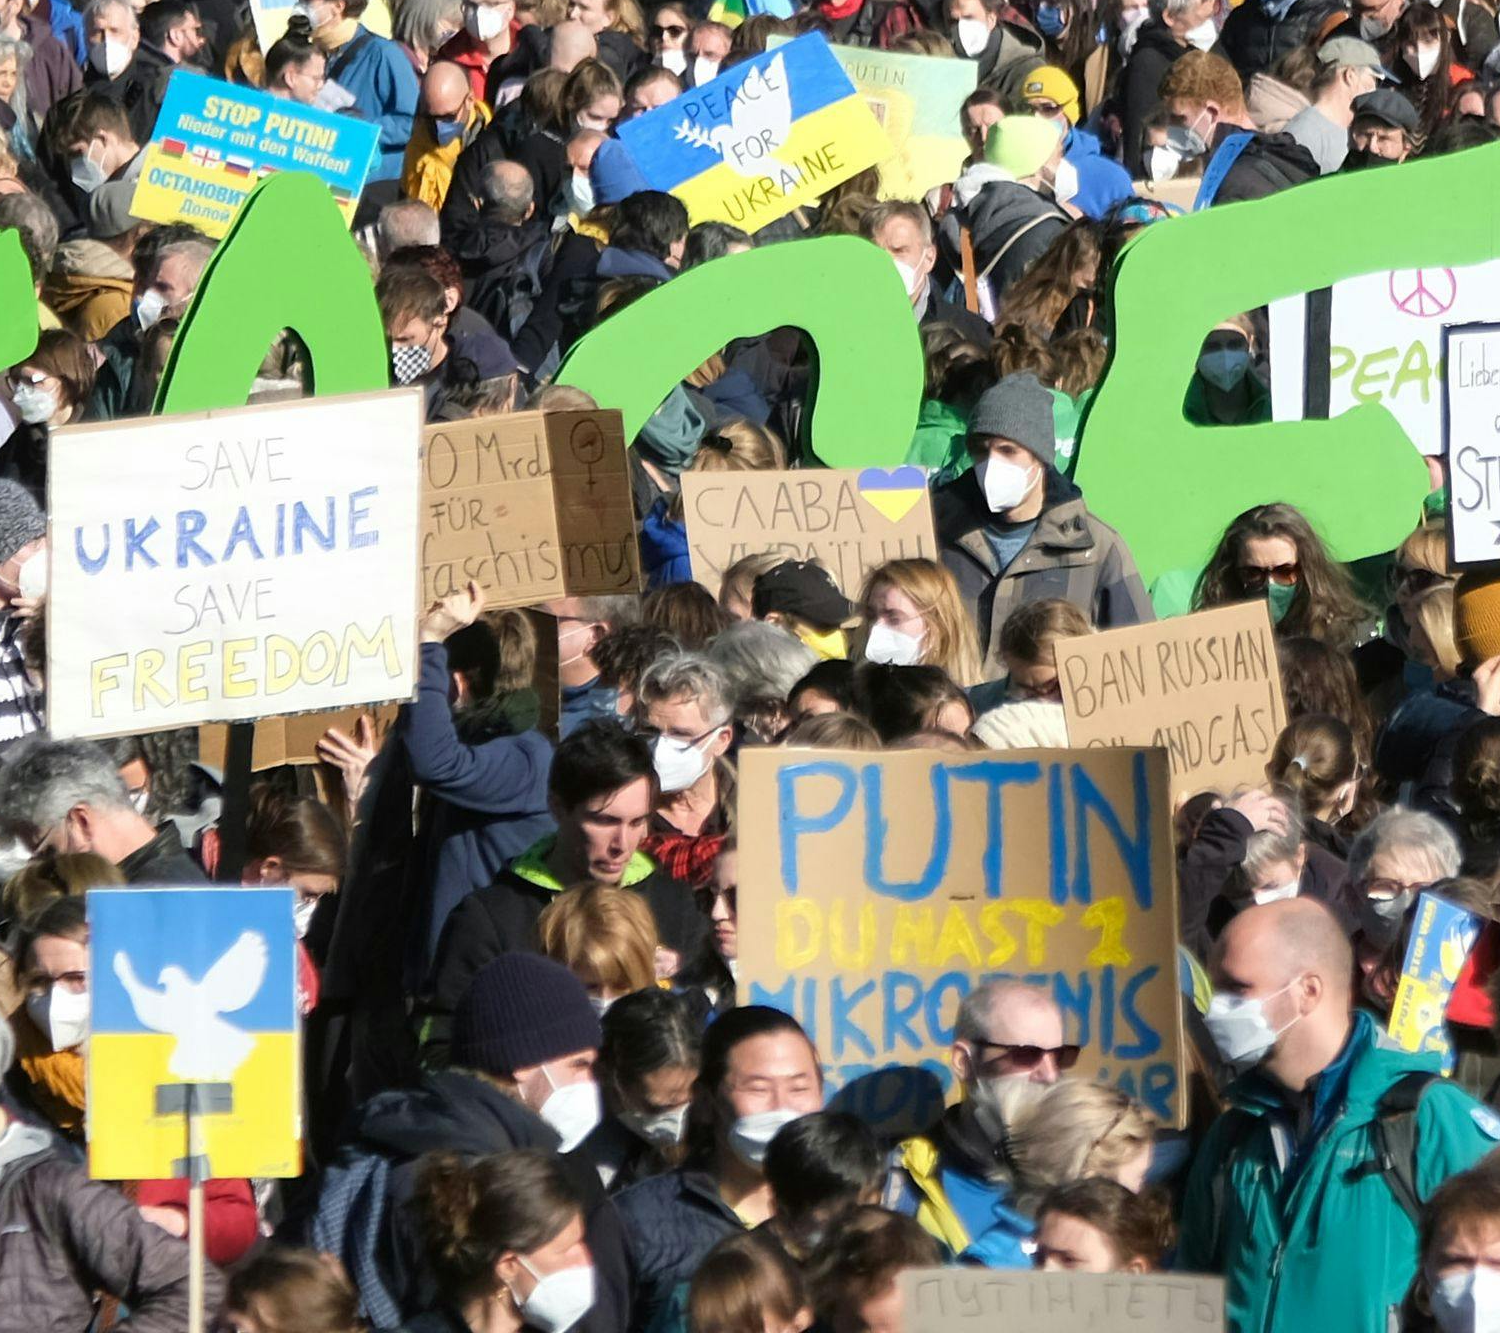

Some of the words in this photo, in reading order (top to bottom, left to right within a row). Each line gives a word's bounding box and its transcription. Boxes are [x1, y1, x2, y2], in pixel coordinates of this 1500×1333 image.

[203, 94, 262, 127] STOP
[264, 111, 339, 152] PUTIN!
[683, 66, 781, 126] PEACE
[177, 113, 227, 140] Nieder
[230, 129, 257, 150] mit
[258, 136, 288, 158] den
[292, 145, 351, 175] Waffen!
[731, 128, 781, 167] FOR
[148, 167, 247, 207] ОСТАНОВИ
[179, 198, 232, 223] Долой
[722, 141, 846, 223] UKRAINE
[1331, 340, 1442, 404] PEA
[180, 437, 292, 491] SAVE
[73, 485, 380, 576] UKRAINE
[429, 496, 490, 534] FÜR
[695, 479, 866, 534] СЛАВА
[162, 577, 277, 635] SAVE
[90, 614, 404, 718] FREEDOM
[1064, 645, 1147, 719] BAN
[1156, 628, 1270, 696] RUSSIAN
[776, 752, 1153, 911] PUTIN
[774, 896, 877, 969] DU
[889, 895, 1066, 968] HAST
[1417, 899, 1438, 935] WAR
[1409, 937, 1430, 976] STOP
[749, 963, 1163, 1061] MIKRONIS
[1398, 984, 1415, 1029] PUTIN
